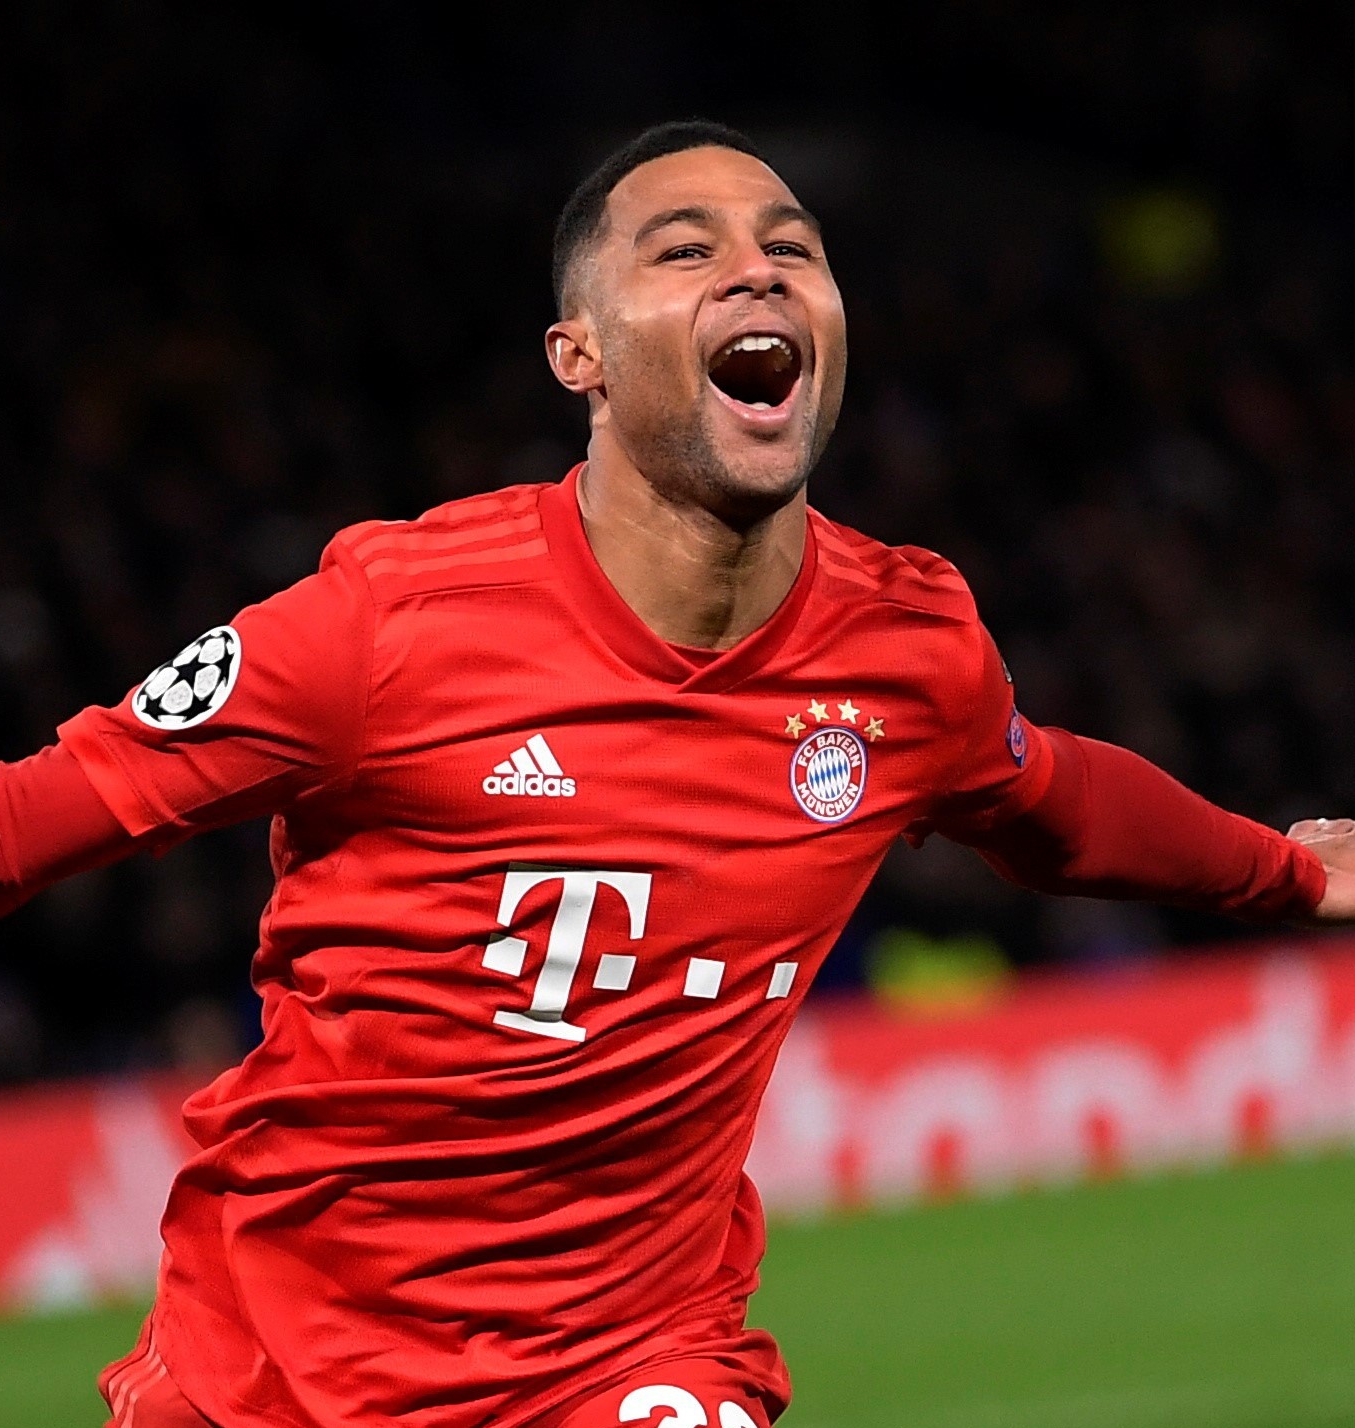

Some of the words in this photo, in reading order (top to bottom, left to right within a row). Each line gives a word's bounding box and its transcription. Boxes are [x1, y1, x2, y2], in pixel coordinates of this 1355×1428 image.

[797, 745, 815, 767] FC
[816, 733, 861, 768] BAYERN
[482, 771, 576, 797] adidas
